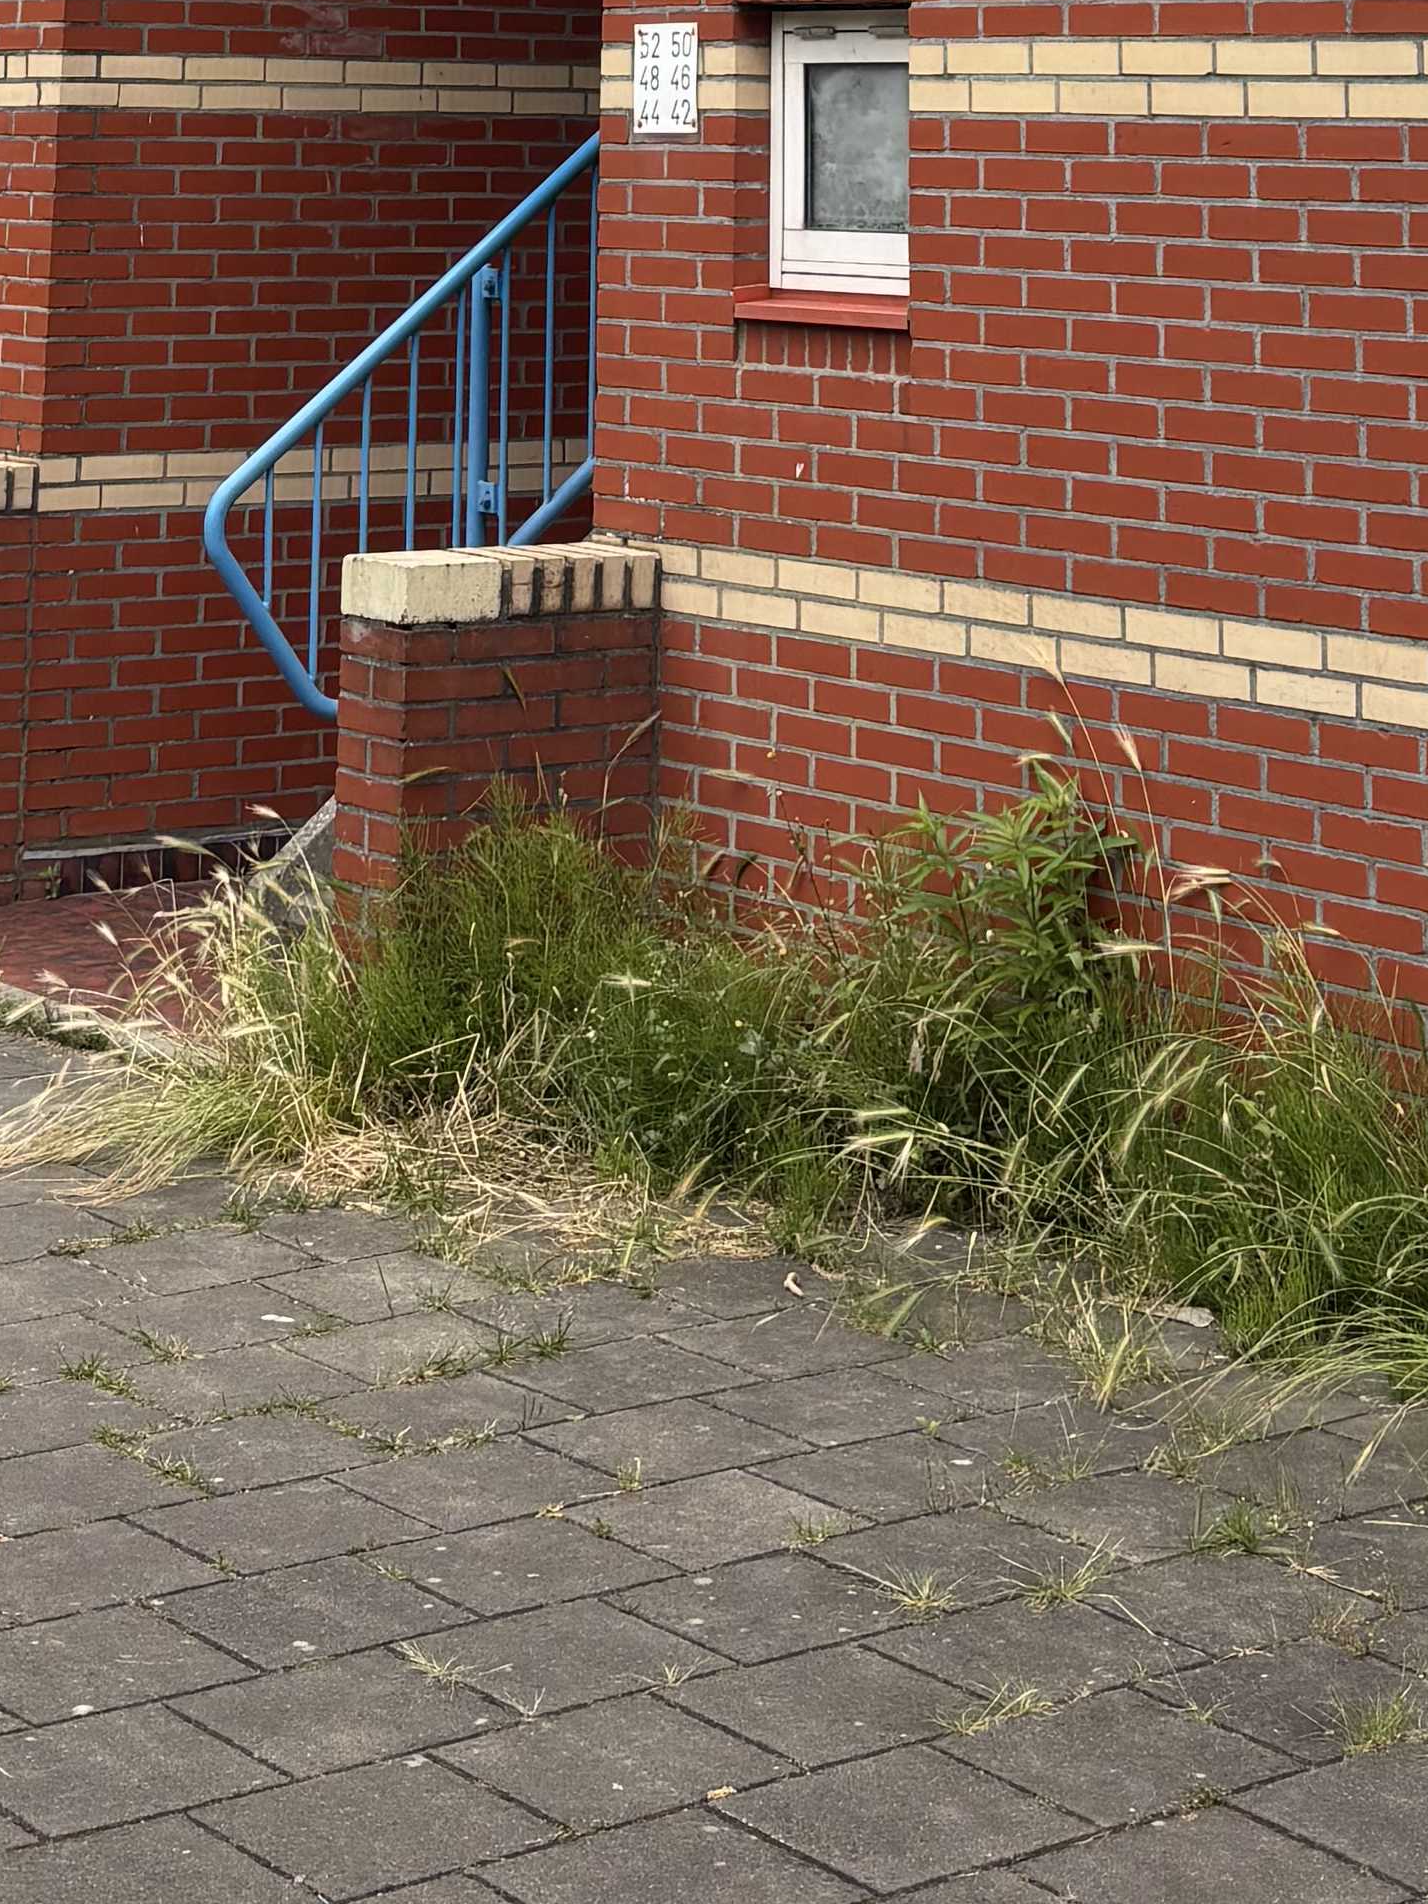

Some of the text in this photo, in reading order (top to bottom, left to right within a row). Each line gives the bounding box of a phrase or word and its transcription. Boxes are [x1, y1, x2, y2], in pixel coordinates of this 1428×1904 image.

[640, 31, 692, 59] 52 50
[640, 64, 691, 91] 48 46
[640, 99, 692, 125] 44 42
